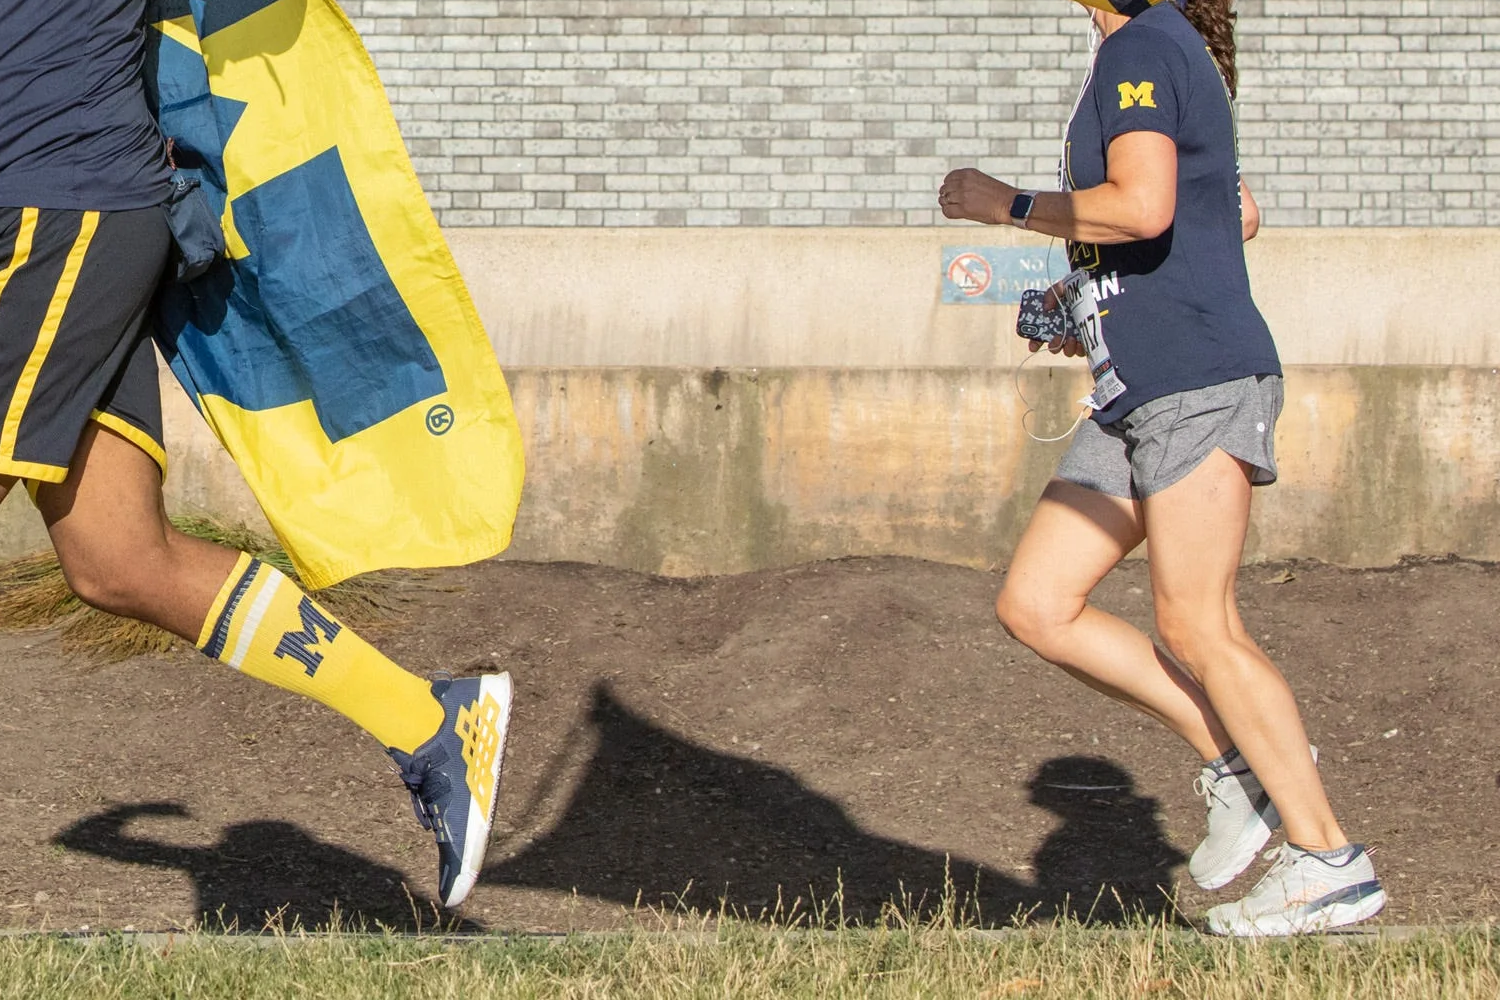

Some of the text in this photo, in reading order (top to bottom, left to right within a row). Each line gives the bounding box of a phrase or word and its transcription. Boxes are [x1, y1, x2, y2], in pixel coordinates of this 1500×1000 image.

[1117, 81, 1156, 110] M
[1019, 258, 1044, 273] NO
[274, 595, 342, 678] M
